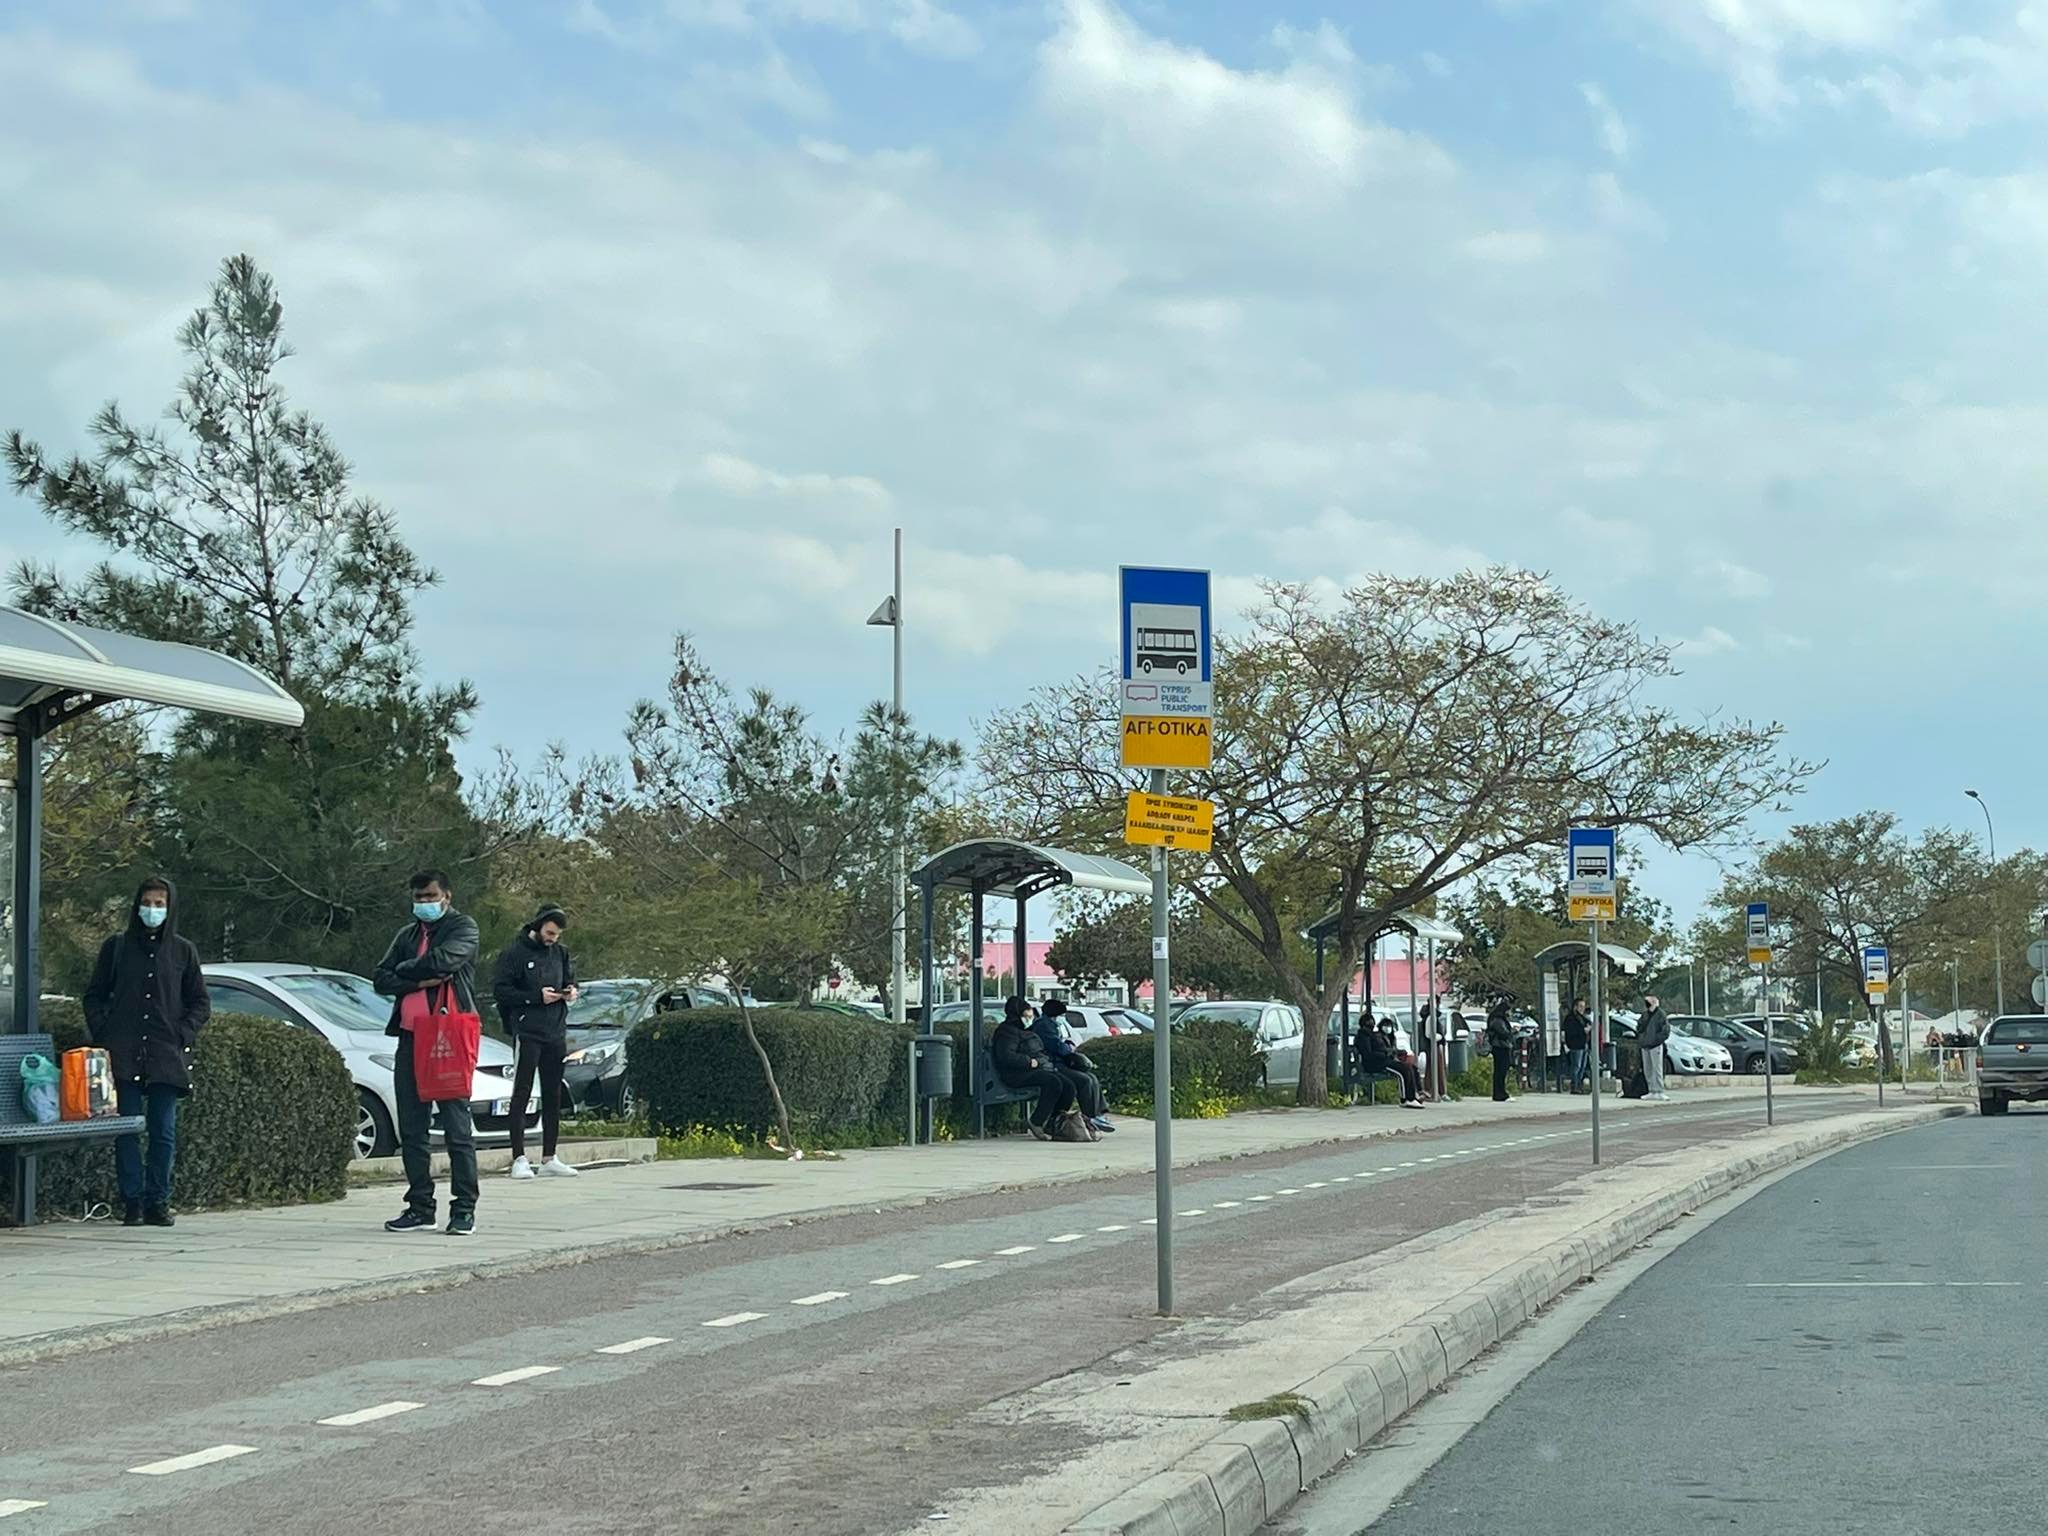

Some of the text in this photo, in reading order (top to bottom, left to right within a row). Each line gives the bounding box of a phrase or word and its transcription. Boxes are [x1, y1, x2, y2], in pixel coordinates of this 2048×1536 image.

[1161, 685, 1192, 694] CYPRUS
[1161, 694, 1189, 703] PUBLIC
[1161, 703, 1208, 712] TRANSPORT
